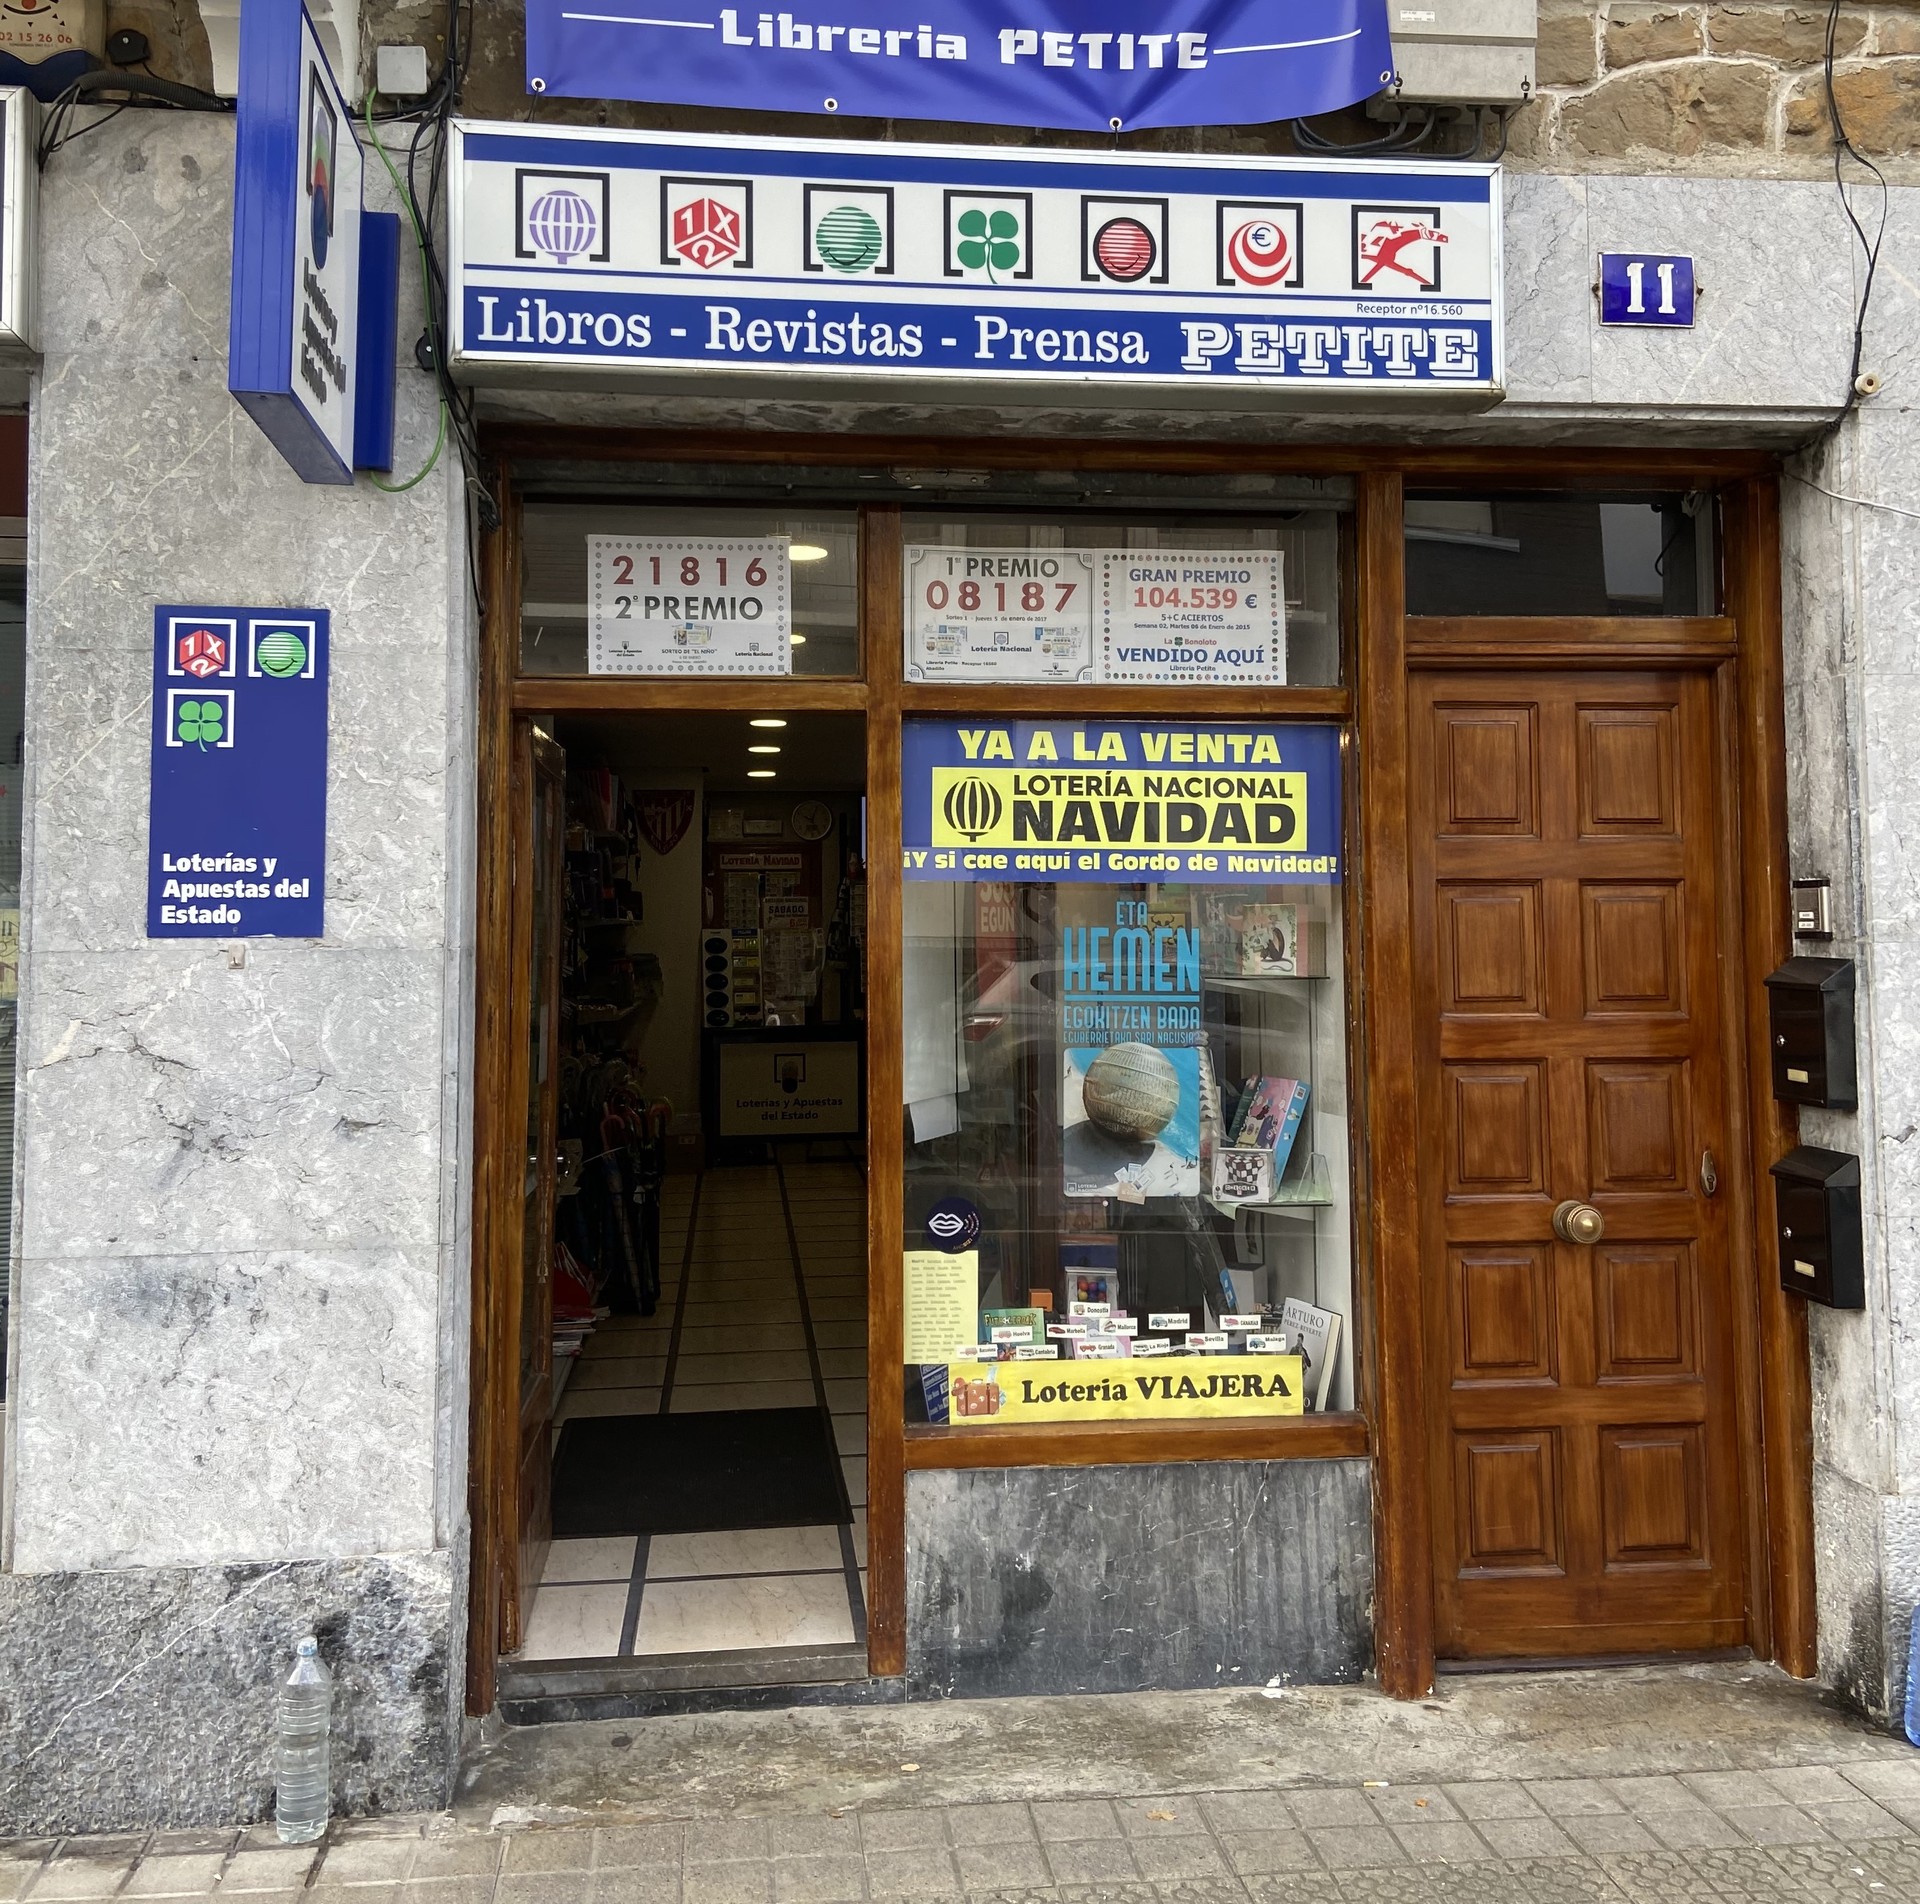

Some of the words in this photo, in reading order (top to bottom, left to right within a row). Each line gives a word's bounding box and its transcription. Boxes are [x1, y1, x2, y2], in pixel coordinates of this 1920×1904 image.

[19, 33, 32, 42] 15
[38, 34, 53, 43] 26
[57, 34, 73, 44] 06
[719, 9, 968, 61] Libreria
[998, 29, 1208, 70] PETITE
[1626, 262, 1677, 314] 11
[1356, 302, 1407, 315] Receptor
[477, 296, 652, 348] Libros
[705, 306, 923, 358] Revistas
[974, 315, 1150, 365] Prensa
[1180, 321, 1479, 377] PETITE
[612, 555, 768, 587] 21816
[966, 557, 1059, 578] PREMIO
[1129, 568, 1177, 582] GRAN
[1182, 570, 1251, 584] PREMIO
[643, 596, 763, 620] PREMIO
[926, 580, 1078, 613] 08187
[1133, 586, 1238, 610] 104.539
[1244, 594, 1258, 609] €
[1161, 613, 1179, 622] 5+C
[1181, 614, 1224, 622] ACIERTOS
[1184, 638, 1217, 646] Bonoloto
[1116, 647, 1208, 663] VENDIDO
[1213, 645, 1265, 667] AQUÍ
[957, 729, 1015, 760] YA
[1027, 730, 1059, 761] A
[1073, 731, 1128, 763] LA
[1140, 732, 1282, 764] VENTA
[1013, 770, 1133, 798] LOTERÍA
[1144, 776, 1293, 799] NACIONAL
[1012, 800, 1297, 844] NAVIDAD
[162, 853, 257, 873] Loterías
[263, 856, 277, 877] y
[935, 851, 956, 869] si
[963, 855, 1008, 870] cae
[1016, 851, 1071, 874] aquí
[1078, 852, 1100, 870] el
[1108, 853, 1180, 871] Gordo
[1188, 853, 1218, 872] de
[1227, 855, 1337, 874] Navidad!
[162, 879, 270, 902] Apuestas
[274, 878, 310, 898] del
[161, 905, 242, 925] Estado
[980, 906, 1015, 932] EGUN
[1116, 901, 1148, 926] ETA
[1063, 927, 1200, 991] HEMEN
[1063, 1005, 1150, 1029] EGOKITZEN
[1157, 1006, 1200, 1029] BADA
[1063, 1031, 1131, 1043] EGUBERRIETAKO
[1134, 1031, 1155, 1044] SARI
[794, 1097, 843, 1108] Apuestas
[761, 1111, 778, 1120] del
[782, 1110, 818, 1120] Estado
[1167, 1317, 1188, 1325] Madrid
[1285, 1306, 1325, 1328] ARTURO
[1021, 1379, 1128, 1404] Loteria
[1135, 1374, 1292, 1400] VIAJERA
